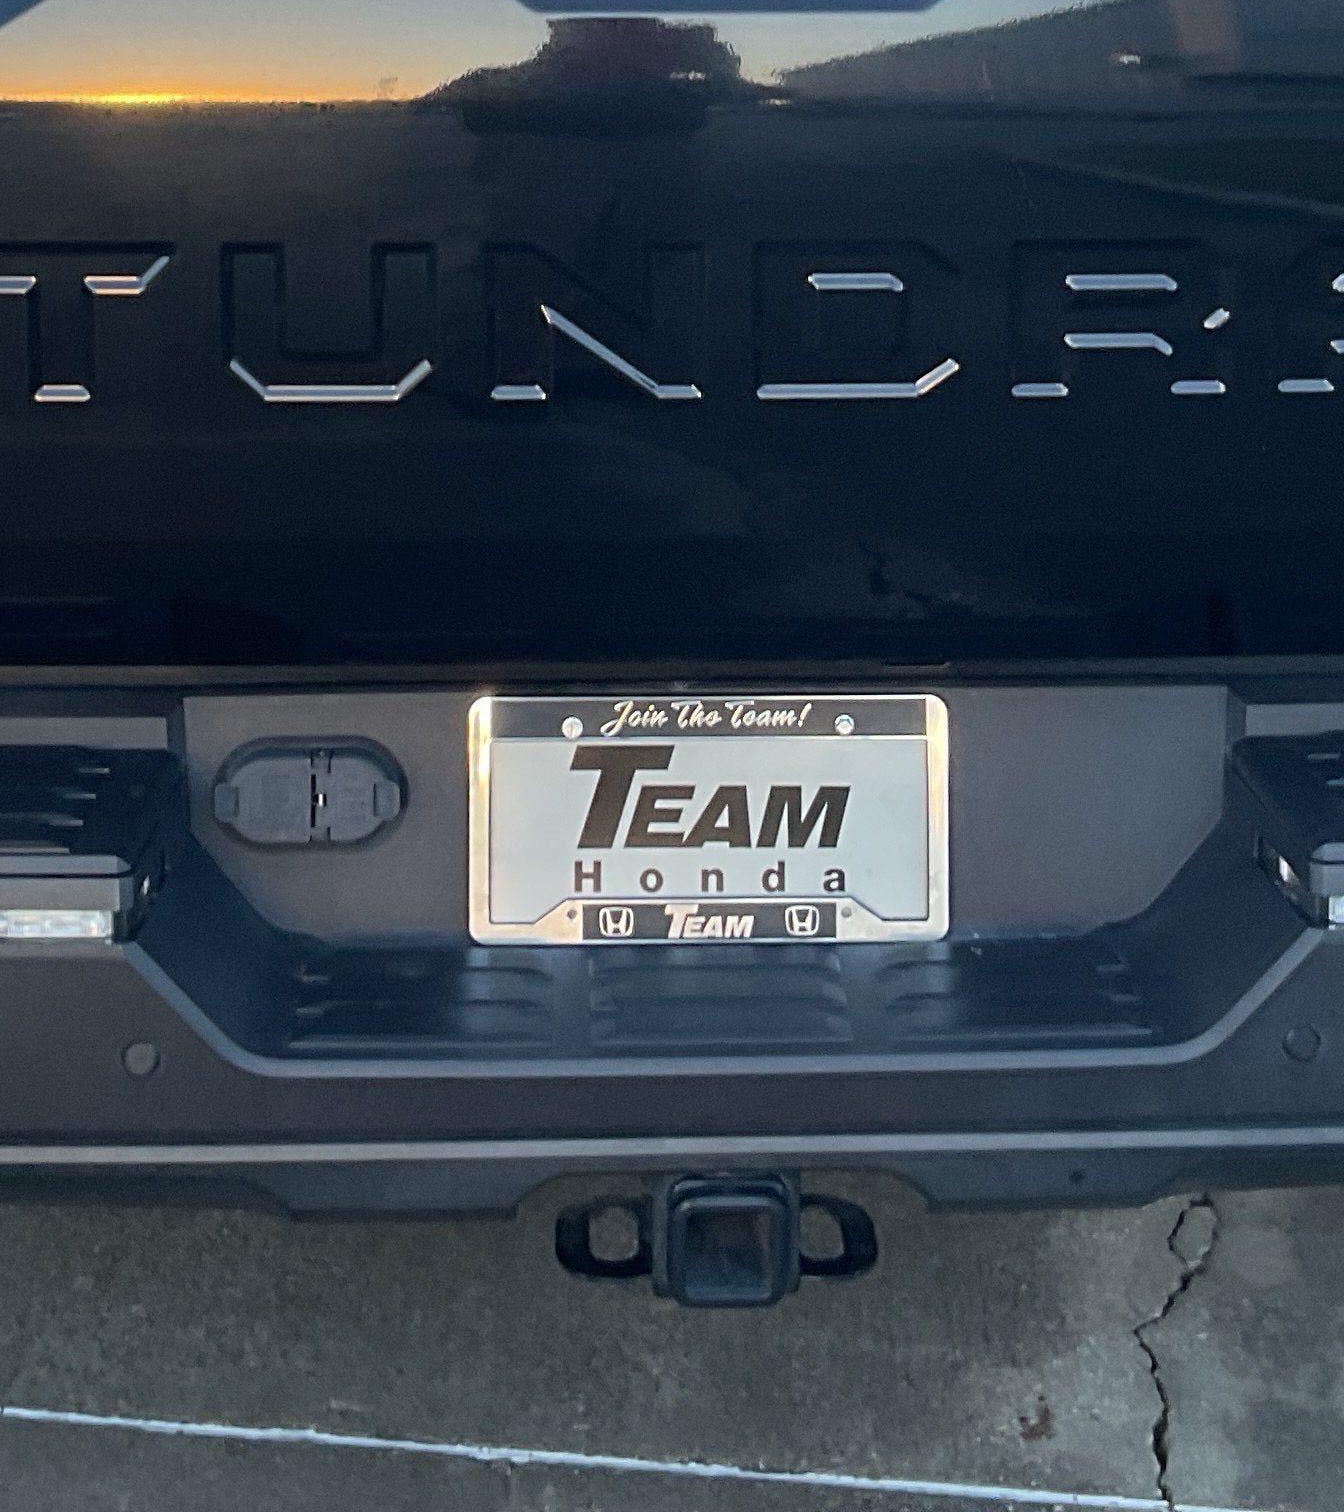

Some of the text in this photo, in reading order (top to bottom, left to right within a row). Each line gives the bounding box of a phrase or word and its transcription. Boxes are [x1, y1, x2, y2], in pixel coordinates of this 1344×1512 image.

[600, 700, 812, 737] Join The Team!
[569, 744, 852, 850] TEAM
[574, 861, 847, 893] Honda
[665, 904, 755, 939] TEAM
